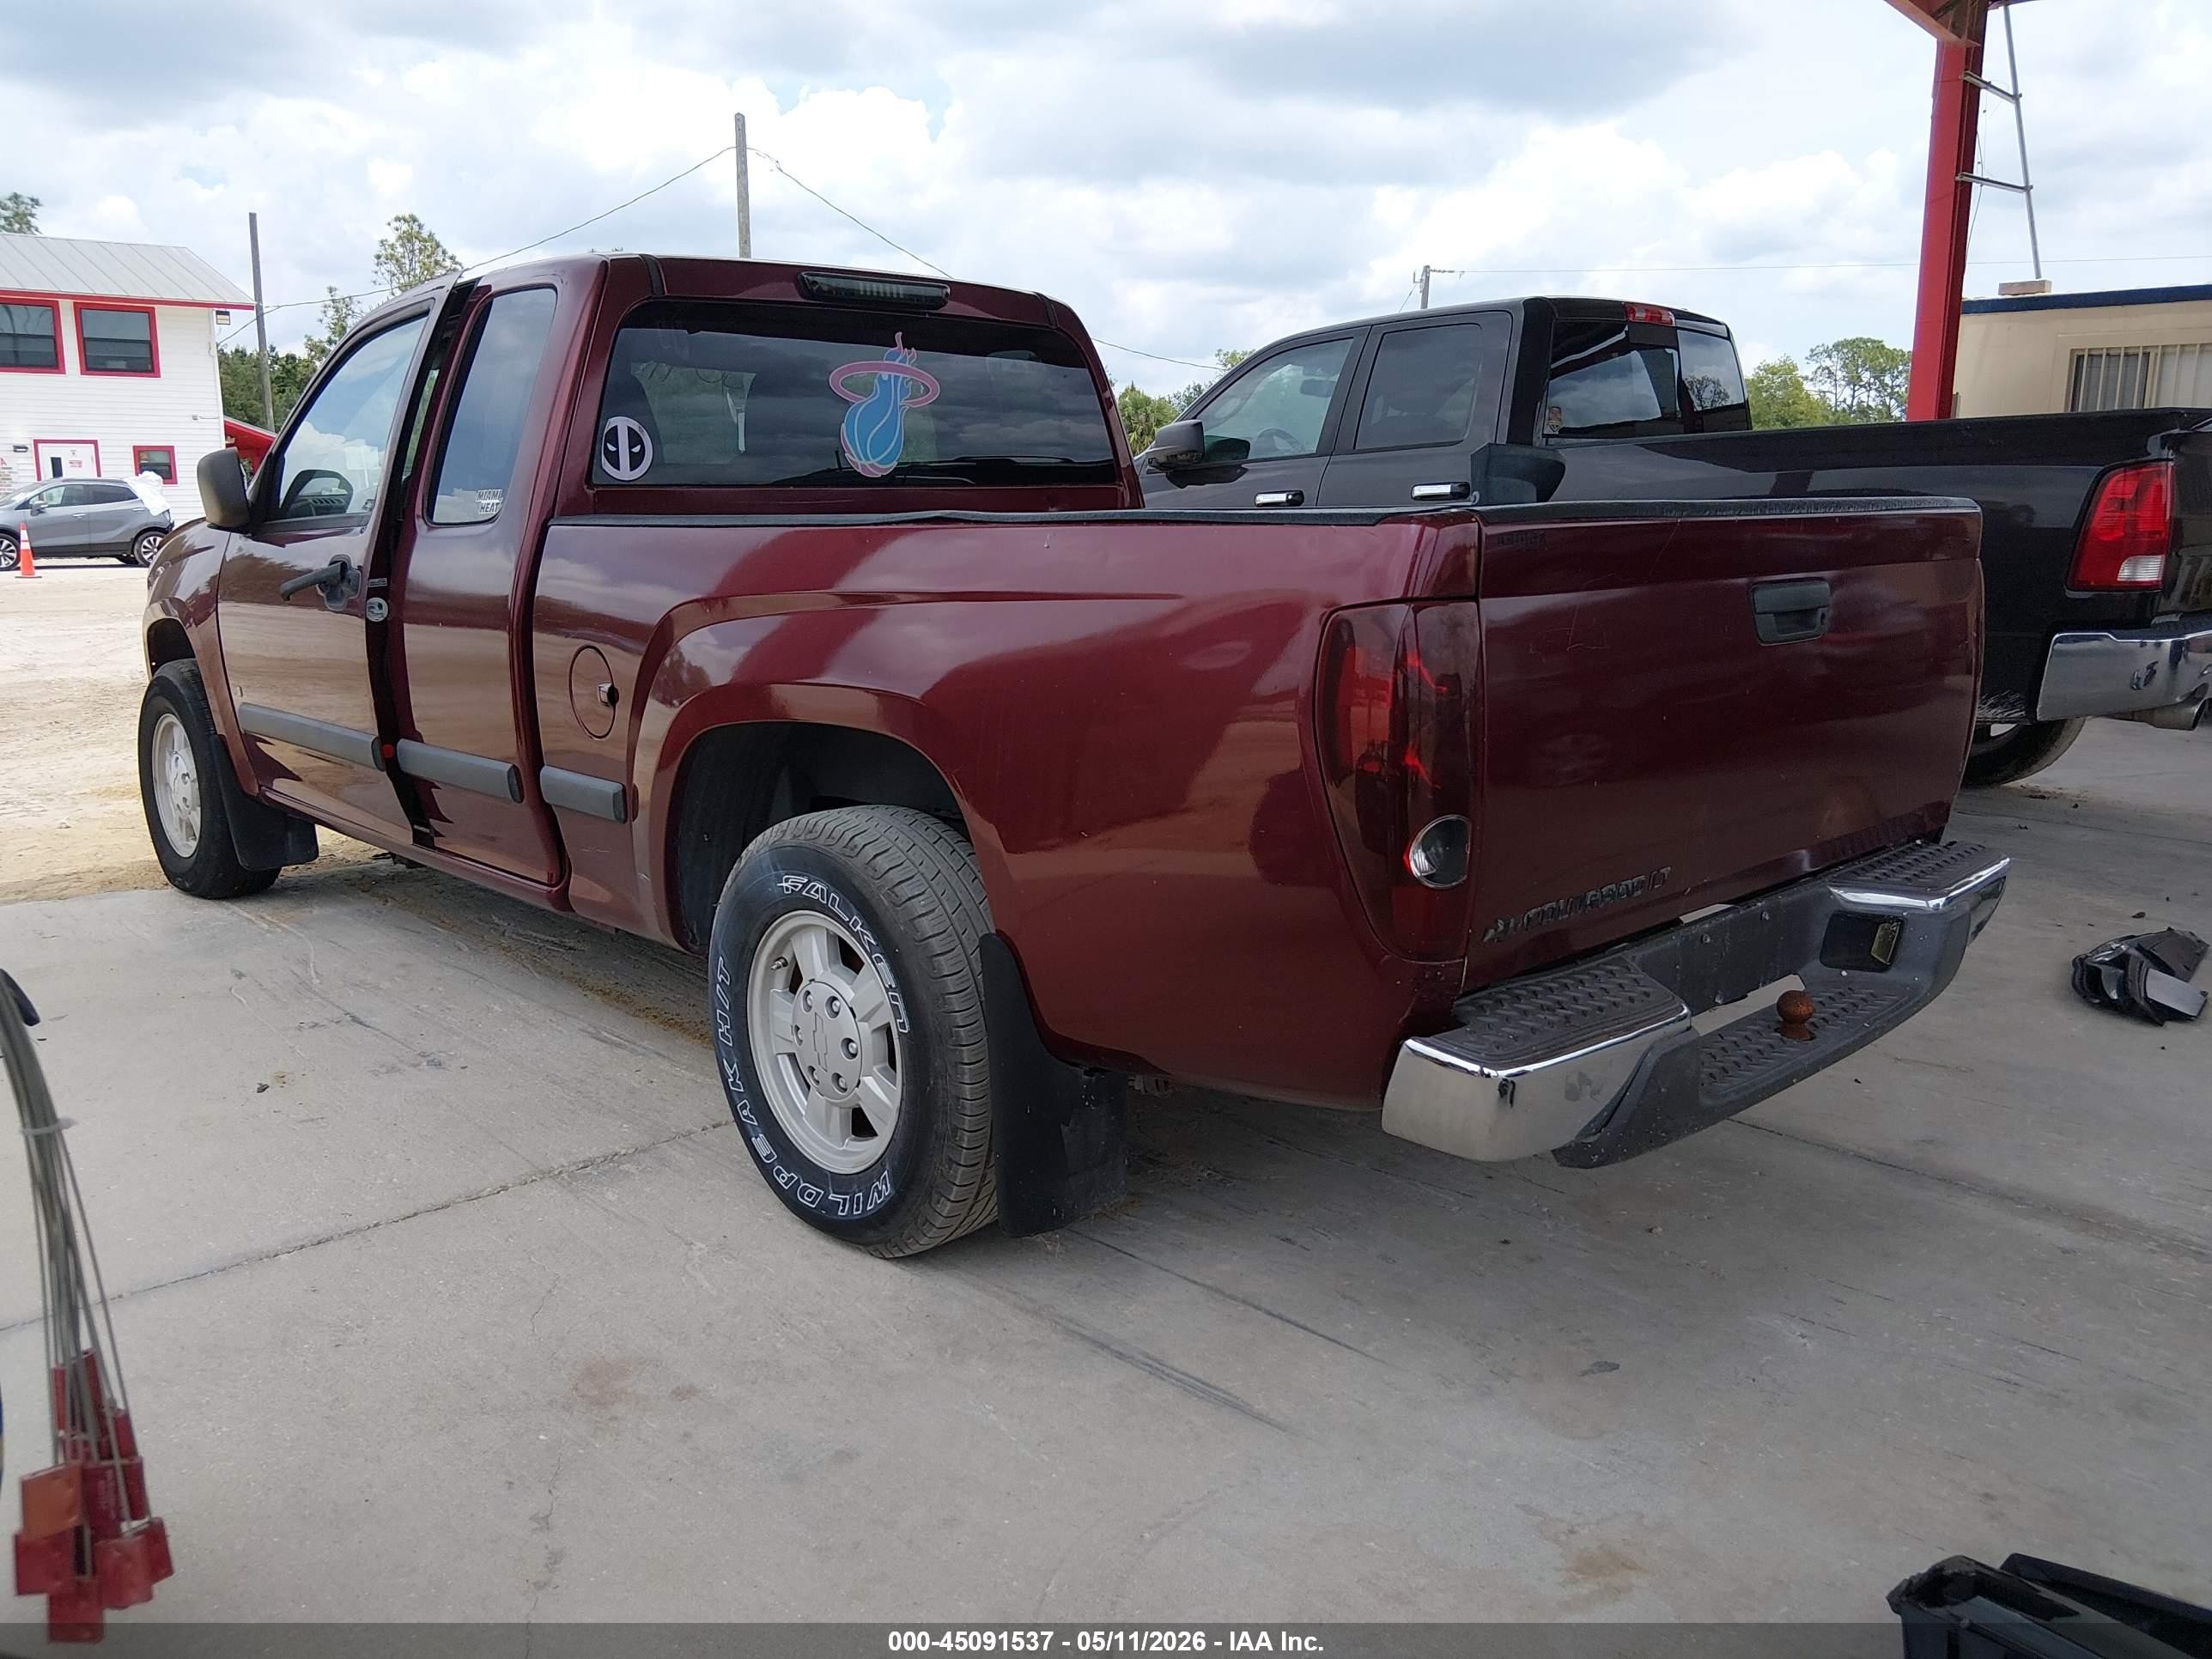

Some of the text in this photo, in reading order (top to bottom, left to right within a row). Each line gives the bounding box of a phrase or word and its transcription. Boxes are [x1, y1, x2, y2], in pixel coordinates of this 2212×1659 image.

[477, 489, 502, 501] MIAMI
[480, 501, 500, 514] HEAT
[777, 874, 910, 1035] FALKEN
[715, 956, 892, 1216] WILDPEAK H/T
